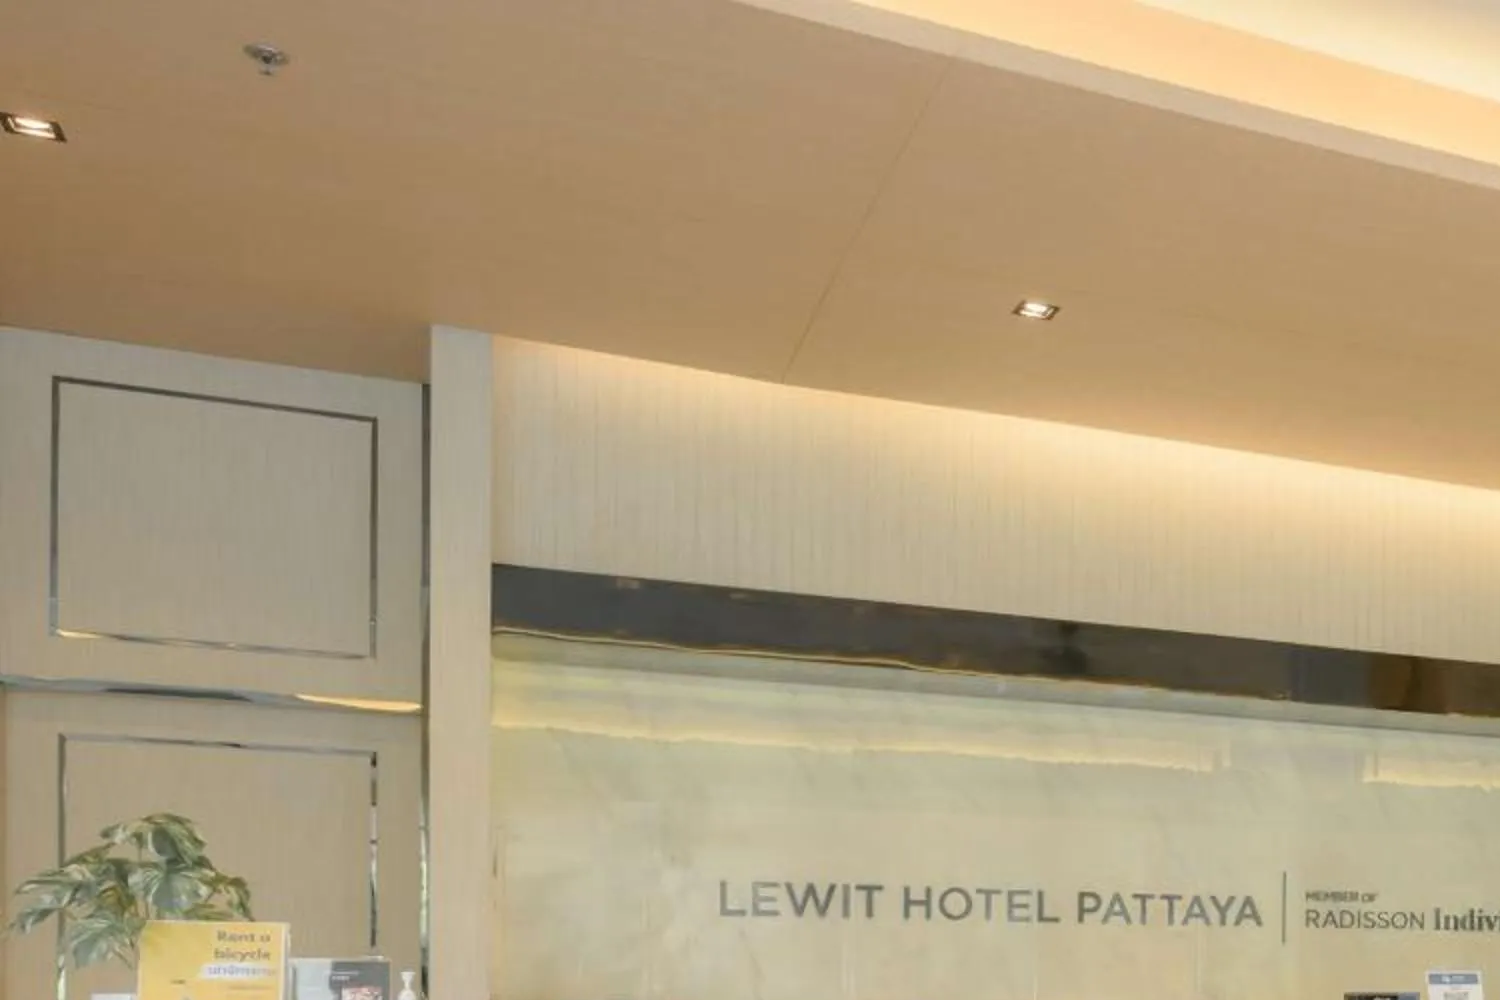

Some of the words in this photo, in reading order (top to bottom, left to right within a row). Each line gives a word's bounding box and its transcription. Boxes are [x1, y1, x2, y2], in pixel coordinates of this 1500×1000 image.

[719, 880, 884, 921] LEWIT
[902, 885, 1060, 923] HOTEL
[1077, 891, 1263, 927] PATTAYA
[1305, 891, 1359, 903] MEMBER
[1361, 893, 1379, 903] OF
[1305, 909, 1425, 930] RADISSON
